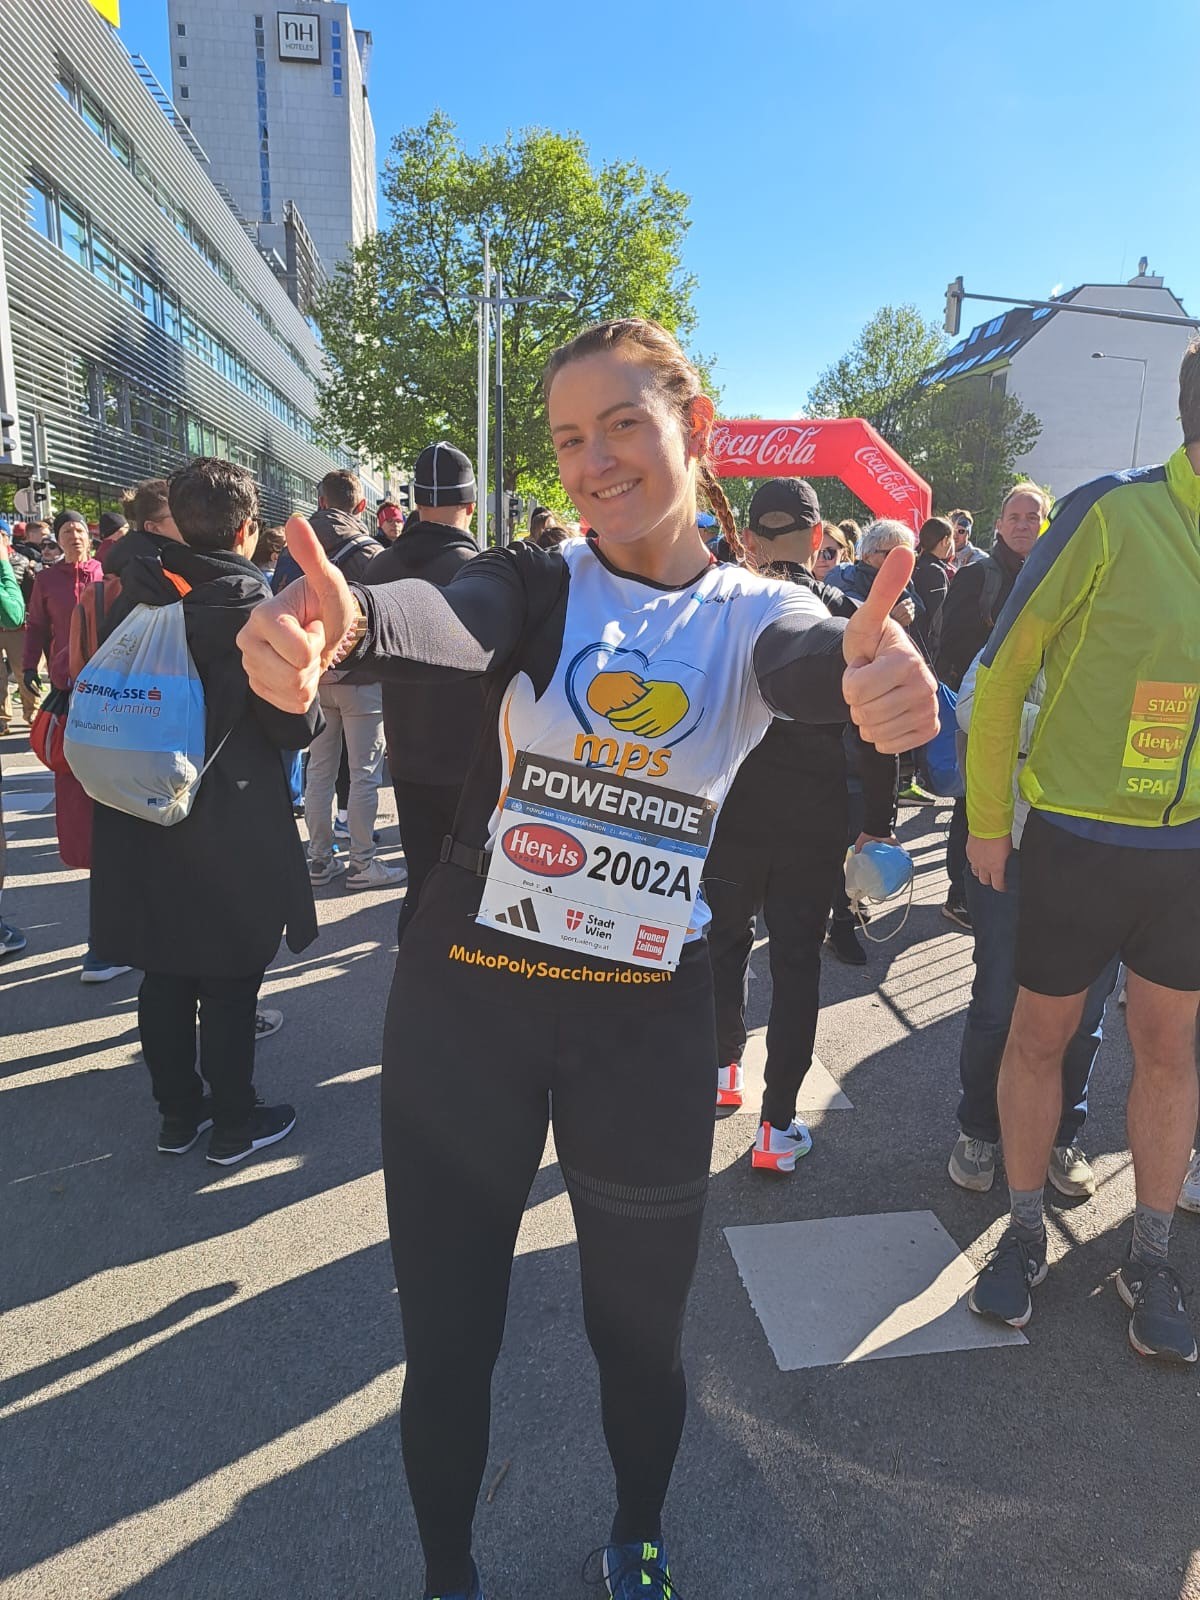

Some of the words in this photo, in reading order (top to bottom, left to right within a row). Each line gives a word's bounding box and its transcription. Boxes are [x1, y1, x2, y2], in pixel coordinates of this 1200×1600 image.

[854, 446, 917, 503] Coca-Cola
[573, 733, 673, 777] mps
[521, 764, 704, 835] POWERADE
[510, 829, 579, 867] Hervis
[587, 845, 692, 902] 2002A
[585, 924, 613, 941] Wien
[587, 914, 616, 930] Stadt
[639, 928, 666, 944] Kronen
[449, 944, 672, 984] MukoPolySaccharidosen
[636, 940, 663, 956] Zeitung
